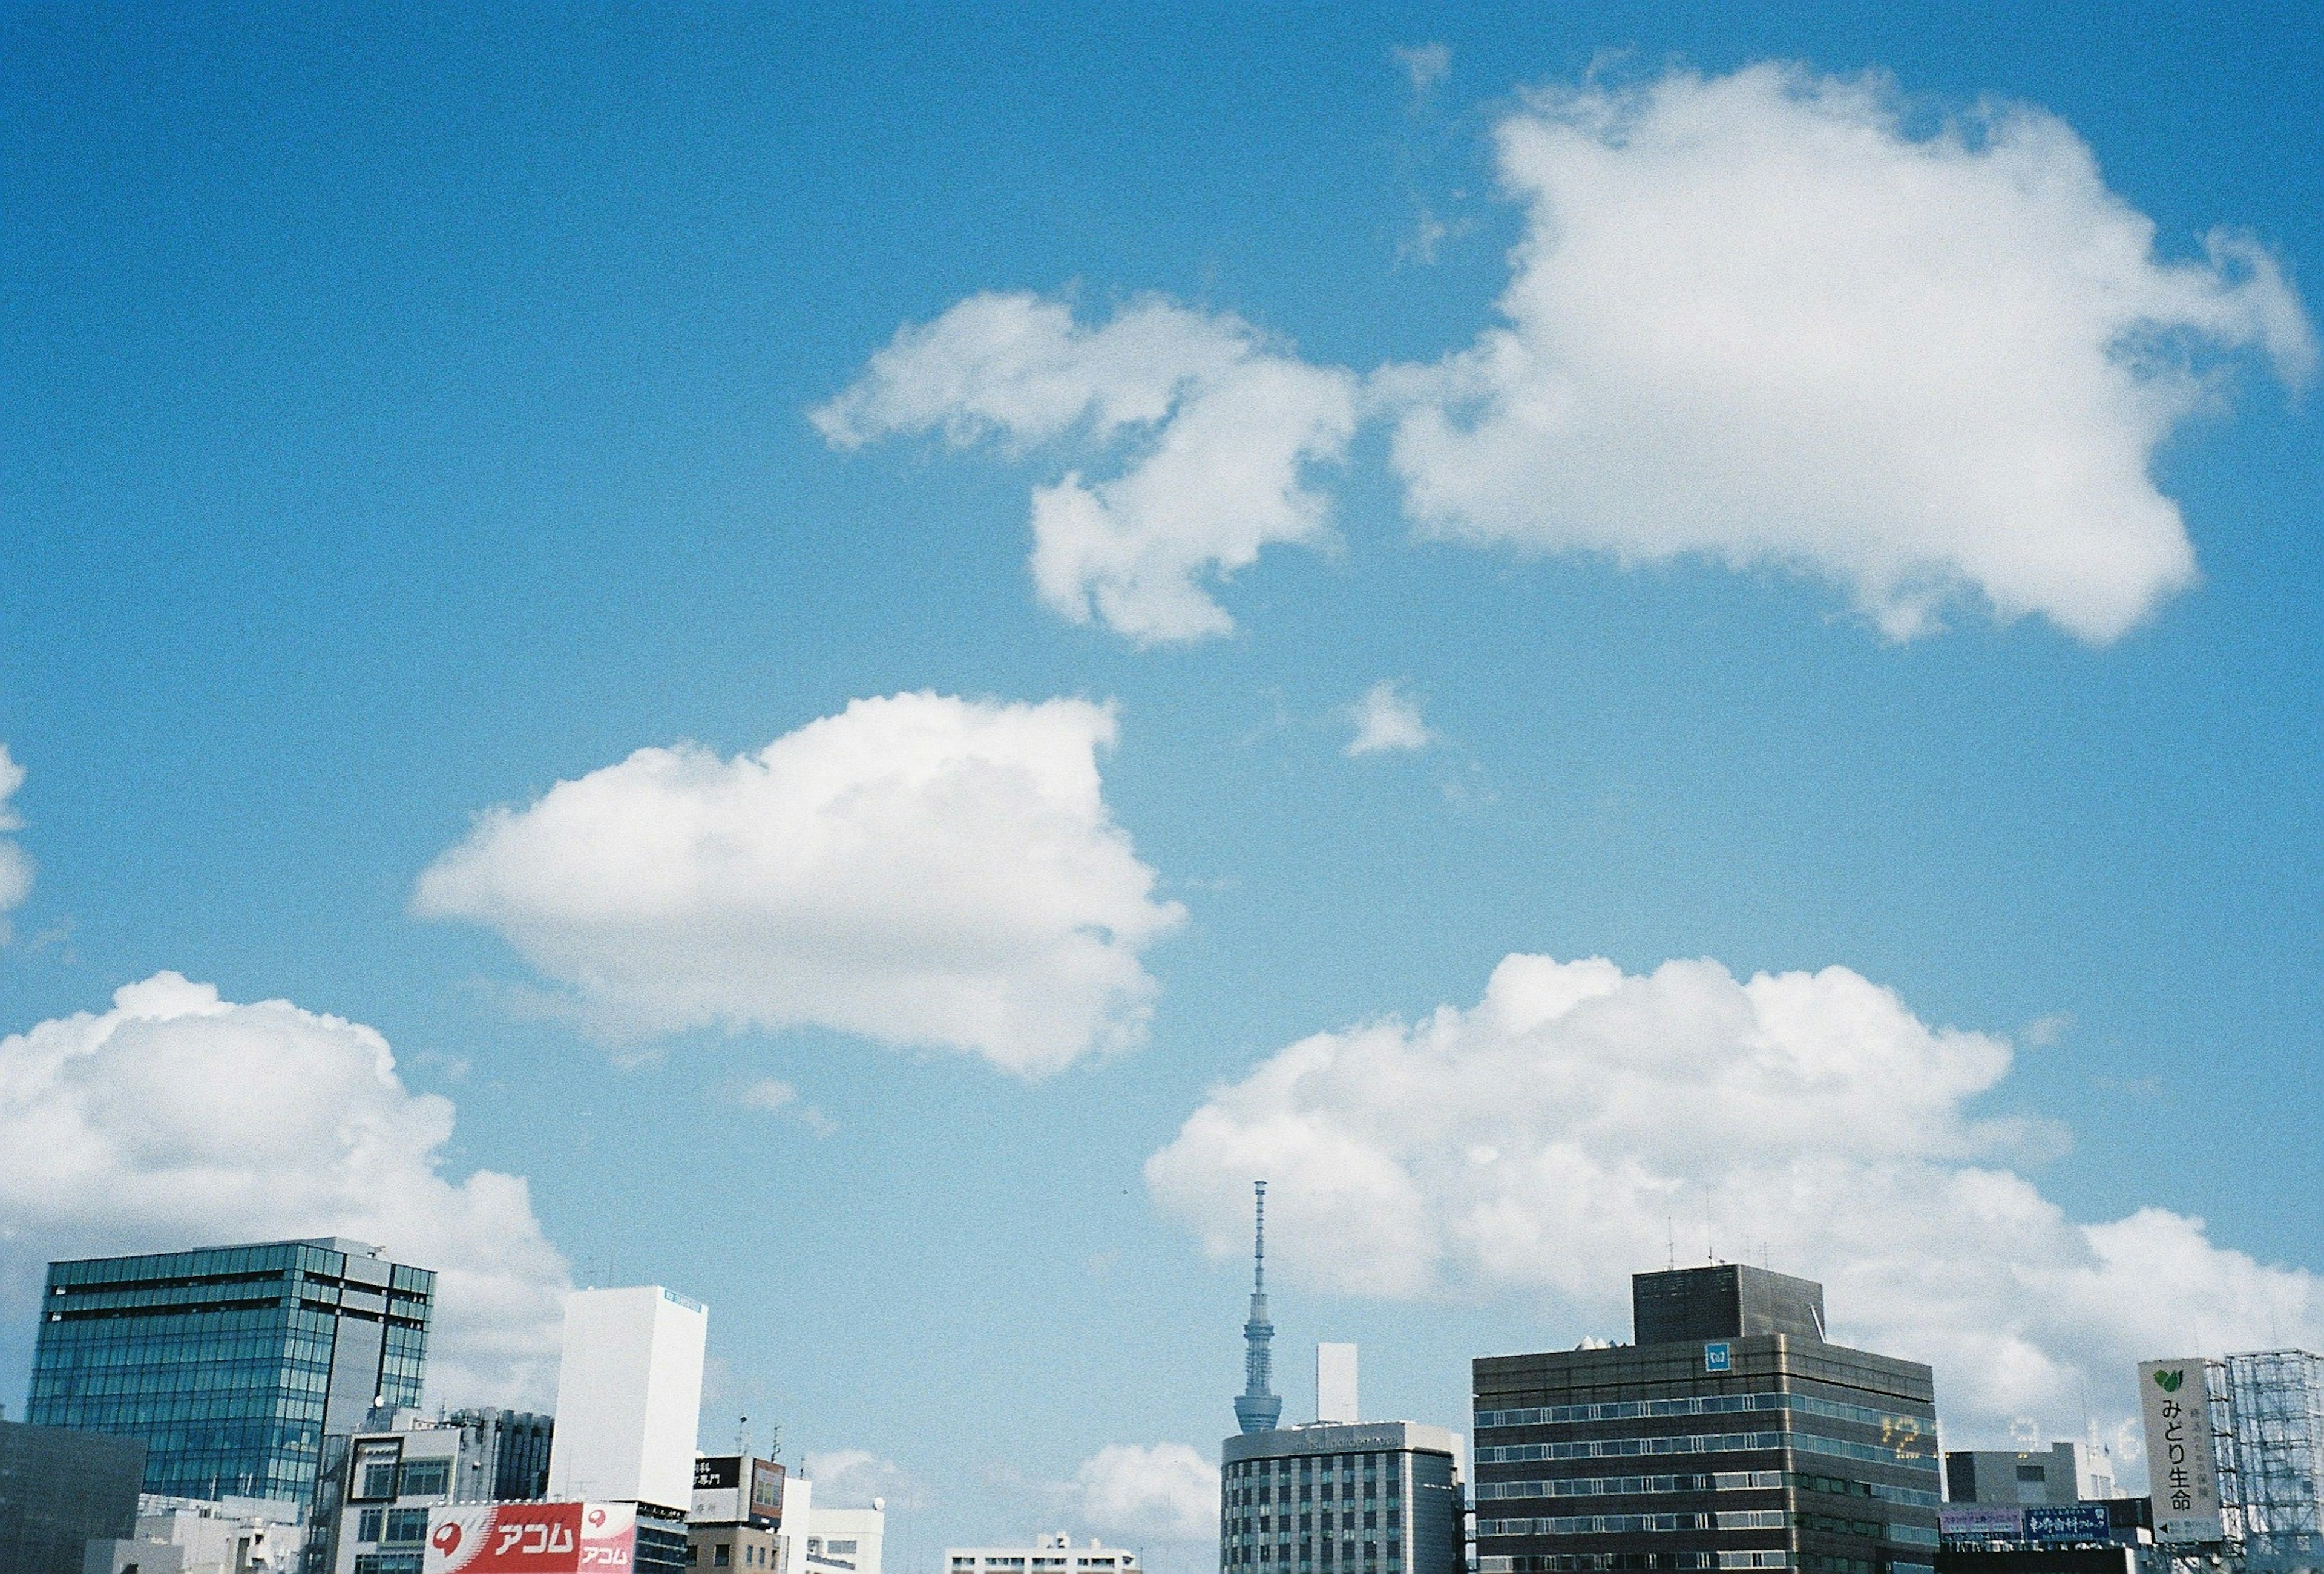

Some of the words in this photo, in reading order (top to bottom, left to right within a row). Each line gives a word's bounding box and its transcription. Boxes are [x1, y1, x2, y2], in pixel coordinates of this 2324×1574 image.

[2162, 1400, 2191, 1512] みどり生命
[495, 1523, 574, 1555] アコム
[582, 1546, 628, 1565] アコム
